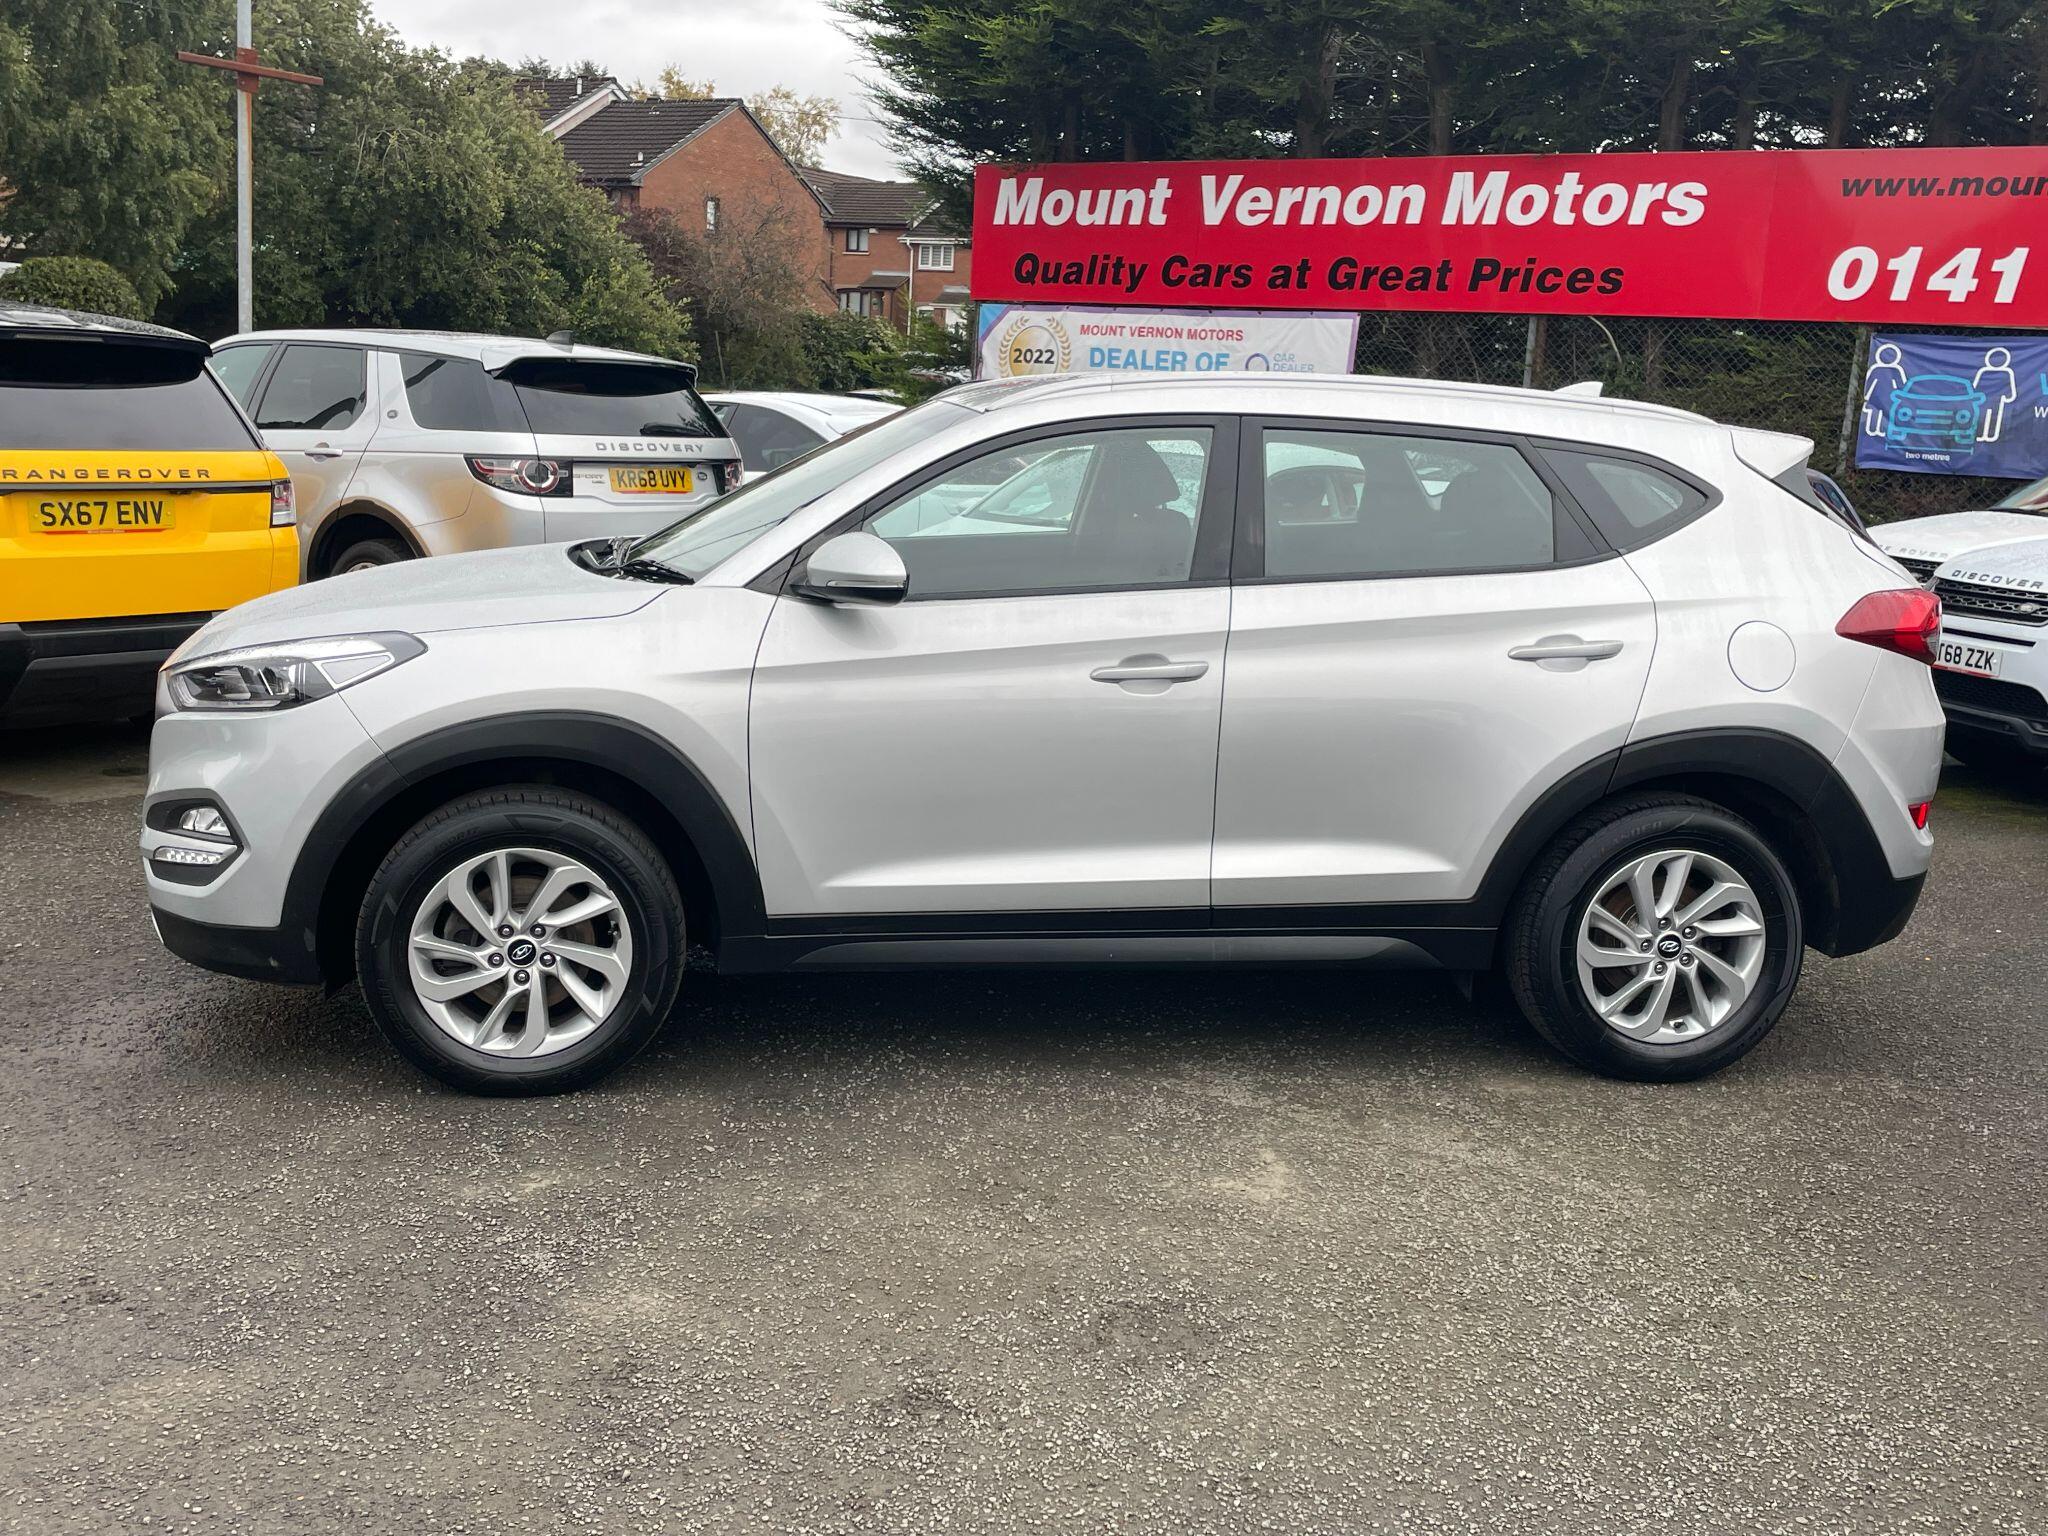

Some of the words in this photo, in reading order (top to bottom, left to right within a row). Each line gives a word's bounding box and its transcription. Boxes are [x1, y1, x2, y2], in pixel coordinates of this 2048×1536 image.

[993, 176, 1172, 226] Mount
[1200, 174, 1426, 226] Vernon
[1441, 170, 1708, 227] Motors
[1014, 253, 1148, 293] Quality
[1161, 255, 1252, 288] Cars
[1267, 258, 1312, 290] at
[1328, 256, 1453, 293] Great
[1467, 257, 1625, 295] Prices
[1827, 246, 2030, 304] 0141
[1080, 324, 1126, 339] MOUNT
[1128, 326, 1184, 340] VERNON
[1187, 328, 1244, 342] MOTORS
[1013, 348, 1055, 365] 2022
[1089, 347, 1188, 371] DEALER
[1195, 351, 1230, 372] OF
[1273, 353, 1295, 364] CAR
[1273, 364, 1315, 373] DEALER
[595, 442, 704, 453] DISCOVERY
[1922, 453, 1951, 461] metres
[616, 469, 658, 488] KR68
[660, 470, 686, 488] UVY
[40, 501, 108, 527] SX67
[117, 500, 164, 526] ENV
[1952, 569, 2044, 589] DISCOVER
[1965, 648, 1995, 671] ZZK
